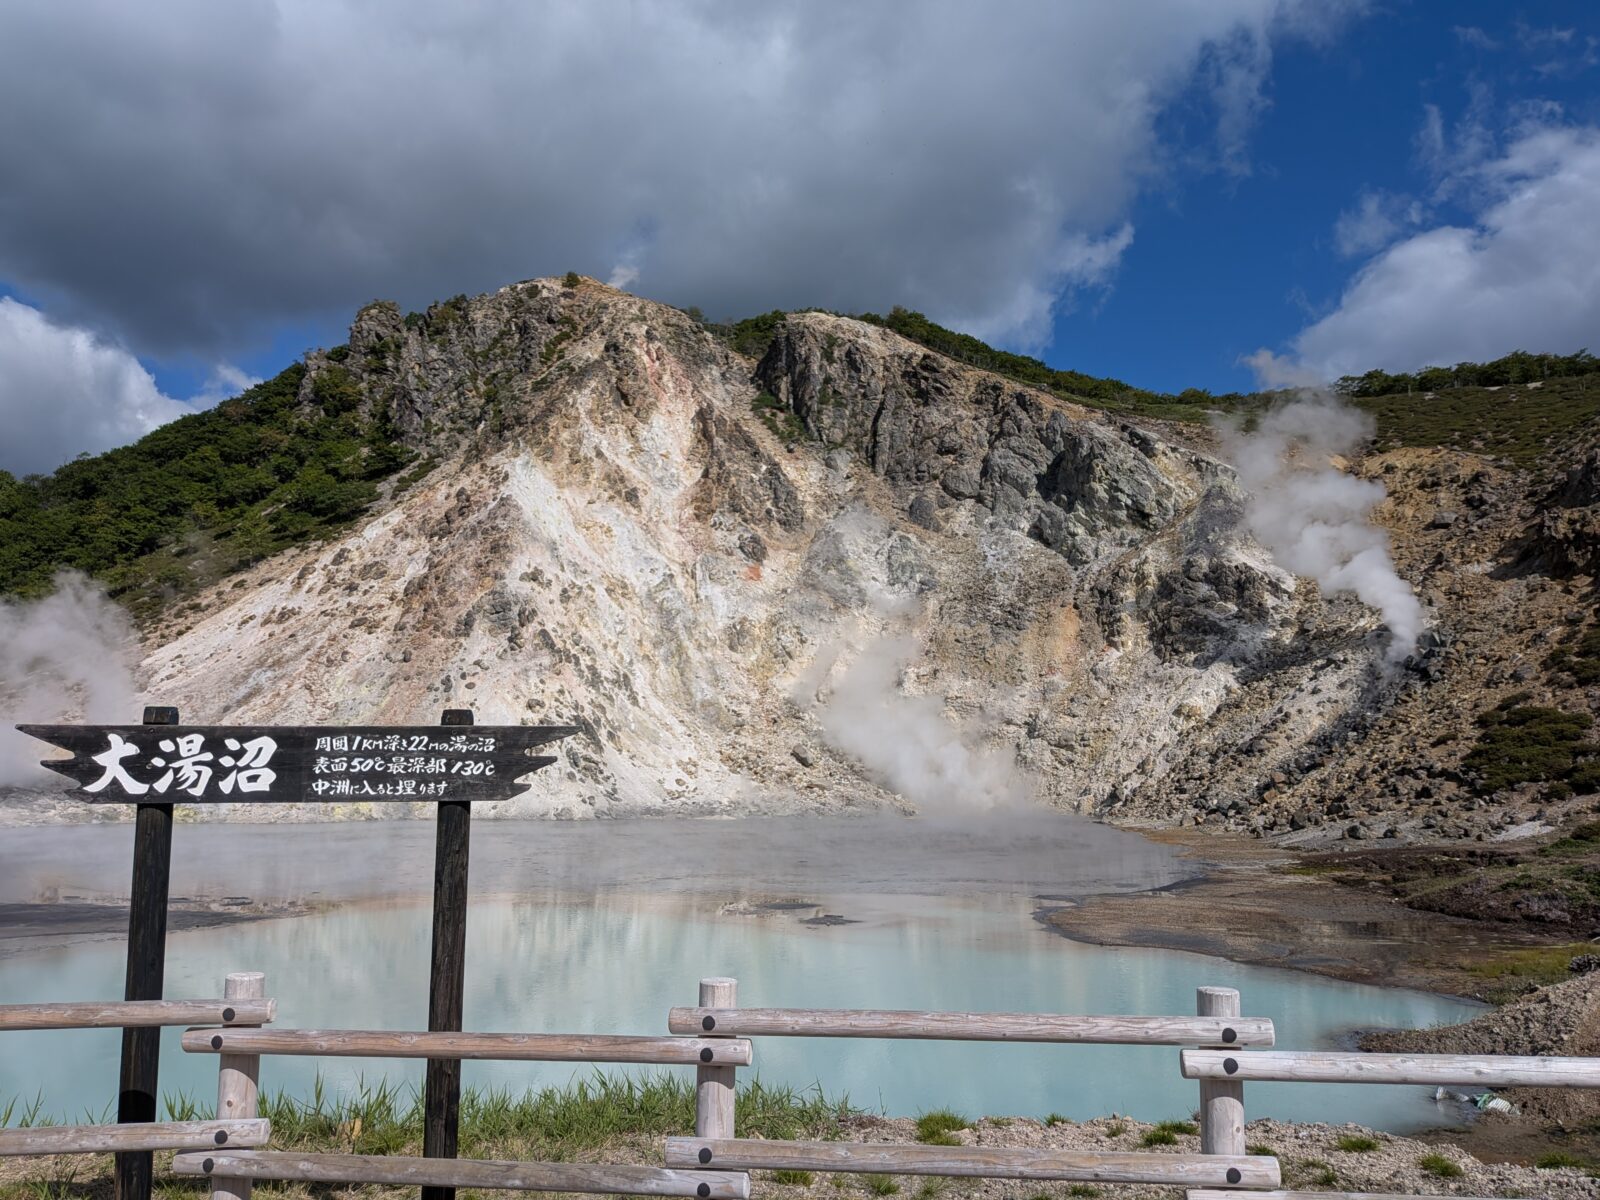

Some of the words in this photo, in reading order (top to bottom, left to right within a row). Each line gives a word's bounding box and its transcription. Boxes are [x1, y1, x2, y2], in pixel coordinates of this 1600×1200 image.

[82, 732, 278, 797] 大湯沼
[311, 778, 448, 797] 中洲に入ると埋ります
